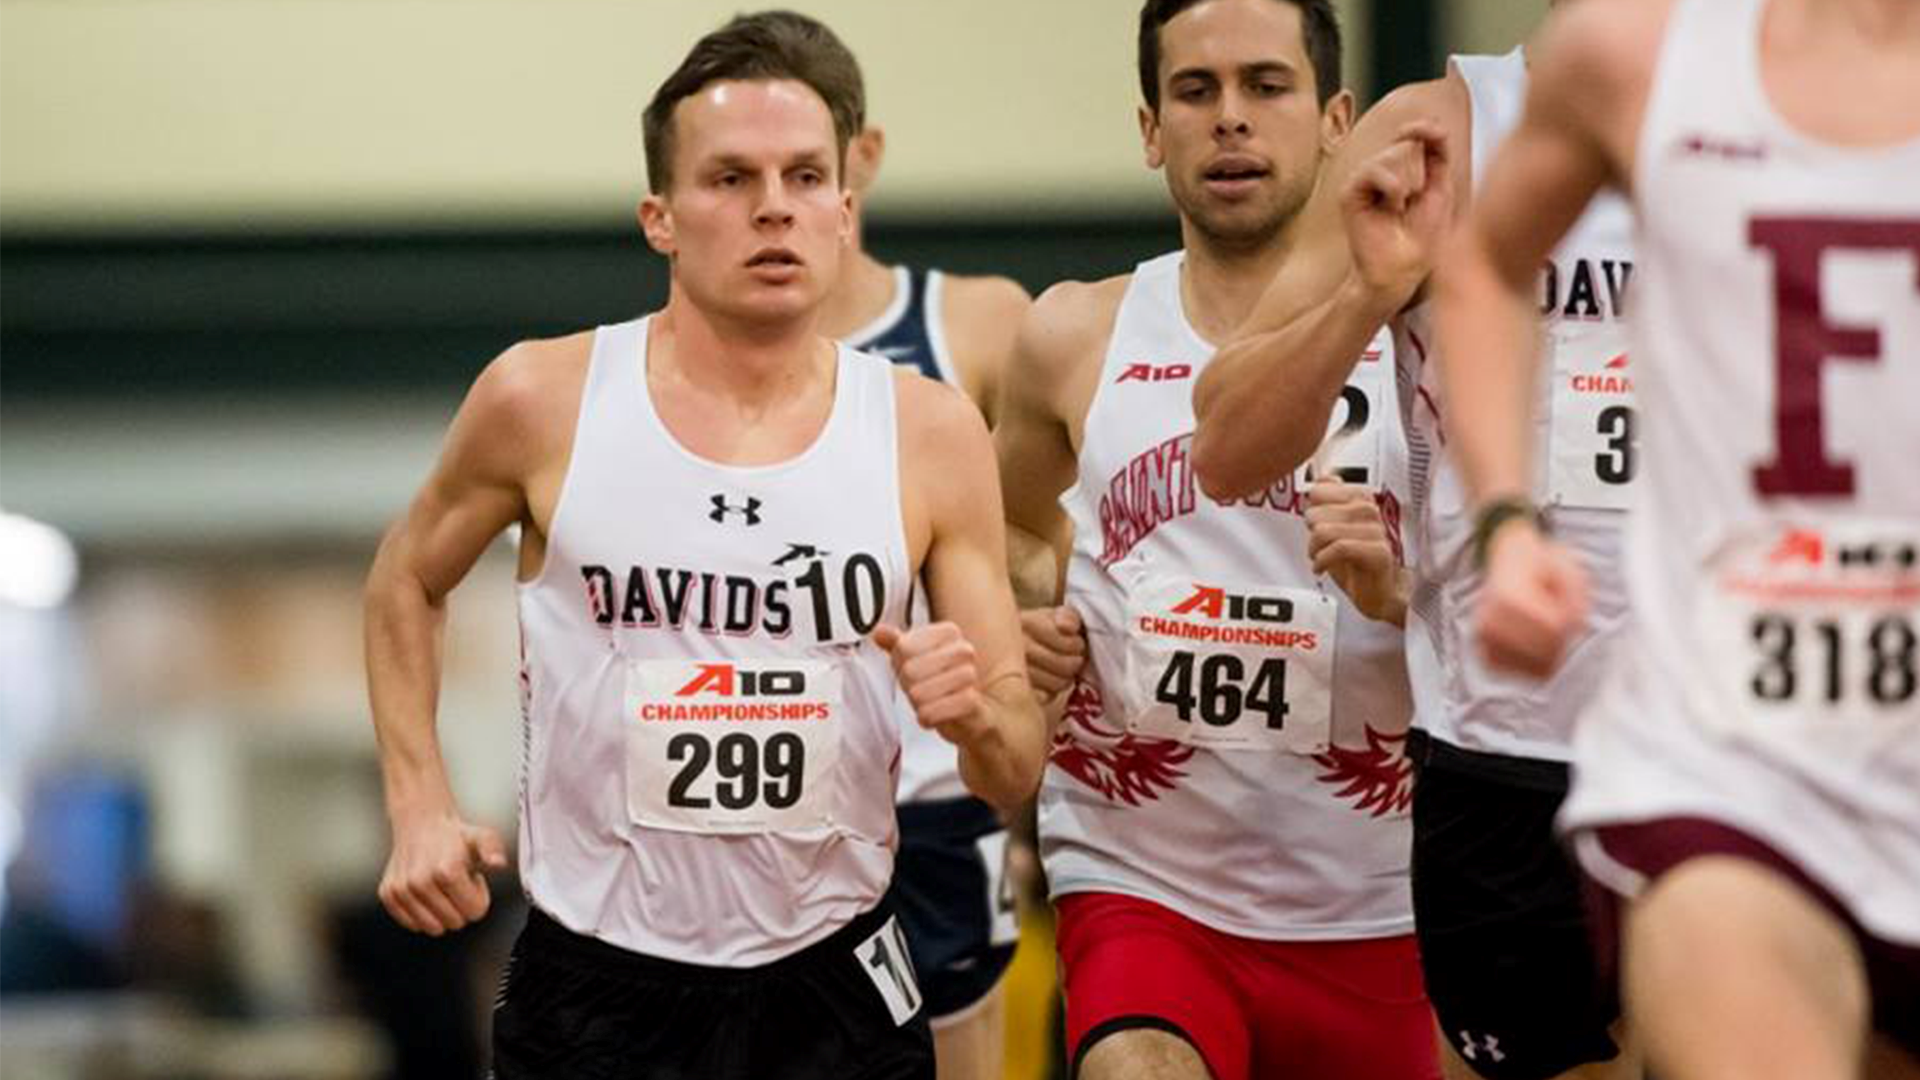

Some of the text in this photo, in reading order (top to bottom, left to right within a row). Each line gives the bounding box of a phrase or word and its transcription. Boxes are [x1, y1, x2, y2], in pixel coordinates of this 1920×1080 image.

[1541, 258, 1633, 318] DAV
[1116, 363, 1191, 383] A10
[1748, 217, 1920, 497] F
[1594, 404, 1636, 485] 3
[580, 564, 795, 640] DAVIDS
[795, 552, 885, 642] 10
[1138, 616, 1317, 650] CHAMPIONSHIPS
[1170, 584, 1293, 622] A10
[674, 663, 806, 696] A10
[1155, 650, 1289, 730] 464
[1751, 612, 1917, 707] 318
[640, 703, 829, 721] CHAMPIONSHIPS
[666, 732, 805, 810] 299
[868, 920, 918, 1012] 1
